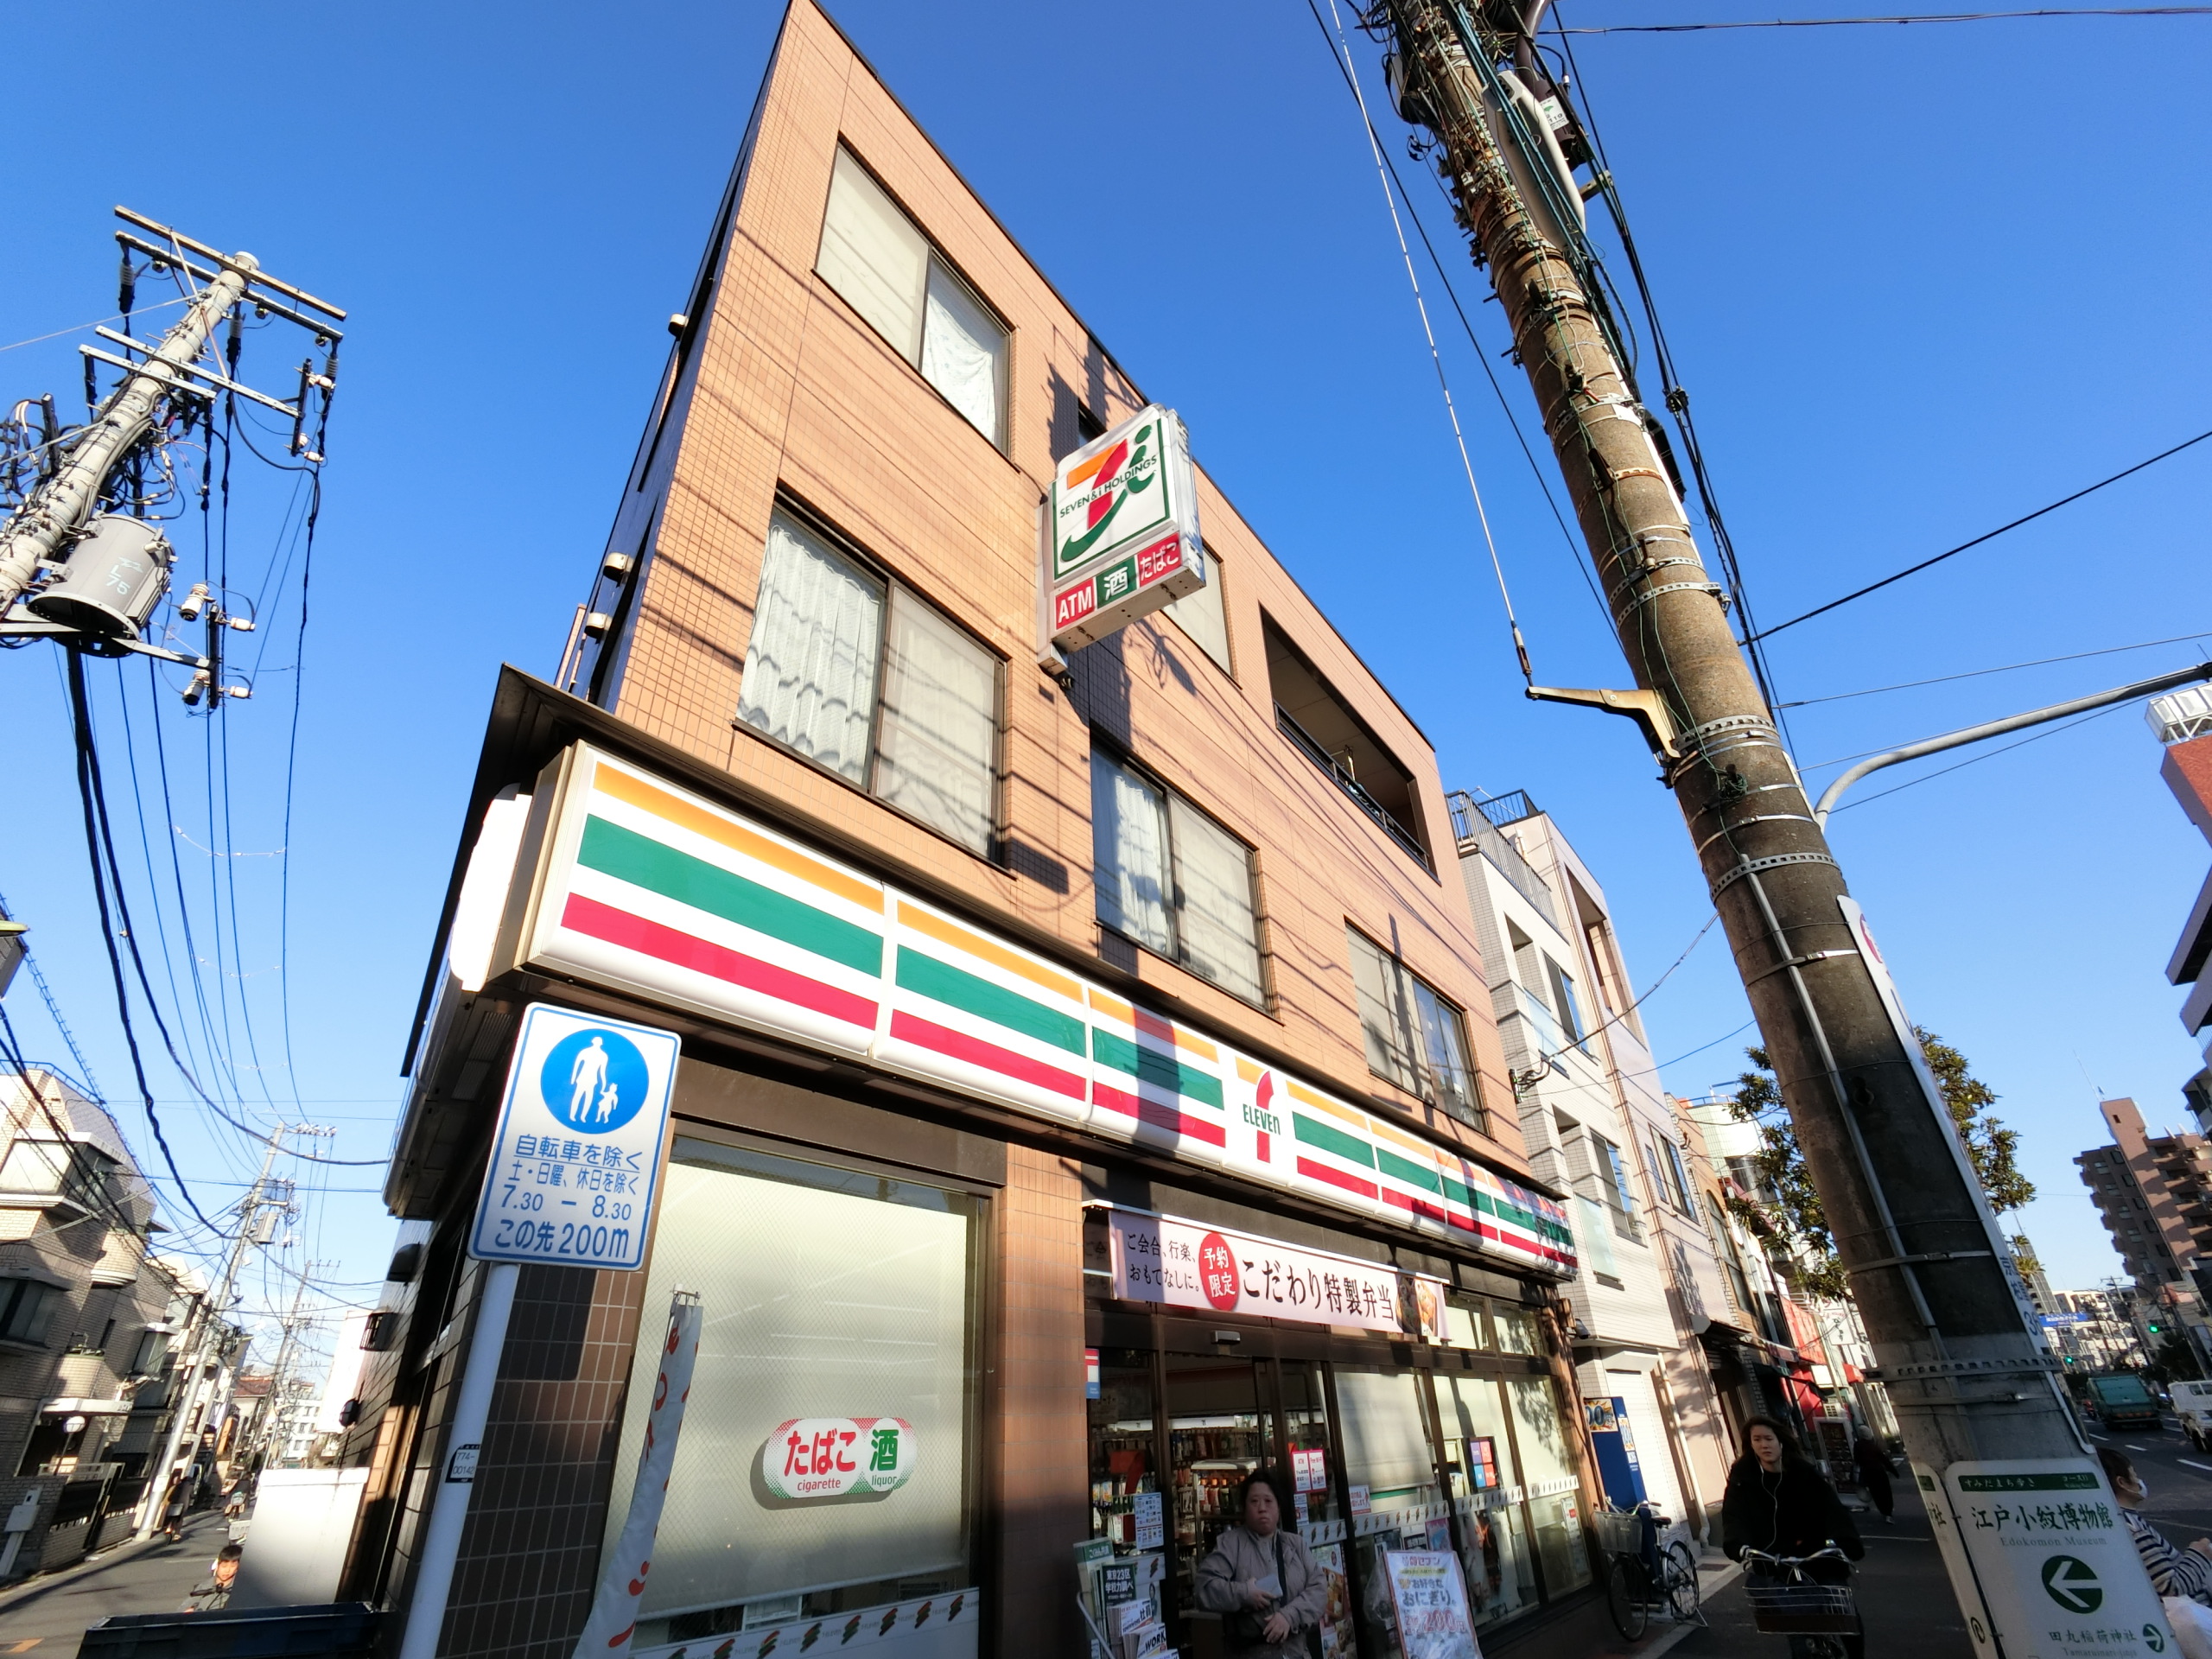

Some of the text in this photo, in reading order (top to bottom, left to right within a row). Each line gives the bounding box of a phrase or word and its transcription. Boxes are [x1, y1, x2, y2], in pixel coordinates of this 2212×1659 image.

[1104, 454, 1157, 493] HOLDINGS
[105, 575, 130, 594] 75
[1058, 543, 1179, 624] ATM 酒 たばこ
[515, 1134, 643, 1170] 自転車を除く
[508, 1160, 639, 1196] 土・日曜、休日を除く
[495, 1218, 630, 1258] この先200m
[1127, 1234, 1196, 1263] ご会合、行楽、
[1204, 1246, 1229, 1270] 予約
[1130, 1264, 1199, 1293] おもてなしに。
[1208, 1272, 1236, 1298] 限定
[1243, 1257, 1394, 1321] こだわり特製弁当
[785, 1427, 899, 1477] たばこ 酒
[797, 1474, 897, 1492] cigarette liquor
[1964, 1478, 2036, 1489] すみだまち歩き
[1972, 1502, 2113, 1532] 江戸小紋博物館
[2001, 1536, 2107, 1547] Edokomon Museum
[1106, 1569, 1131, 1580] 東京23区
[1146, 1630, 1166, 1652] WORK
[2049, 1629, 2138, 1644] 田丸稲荷神社
